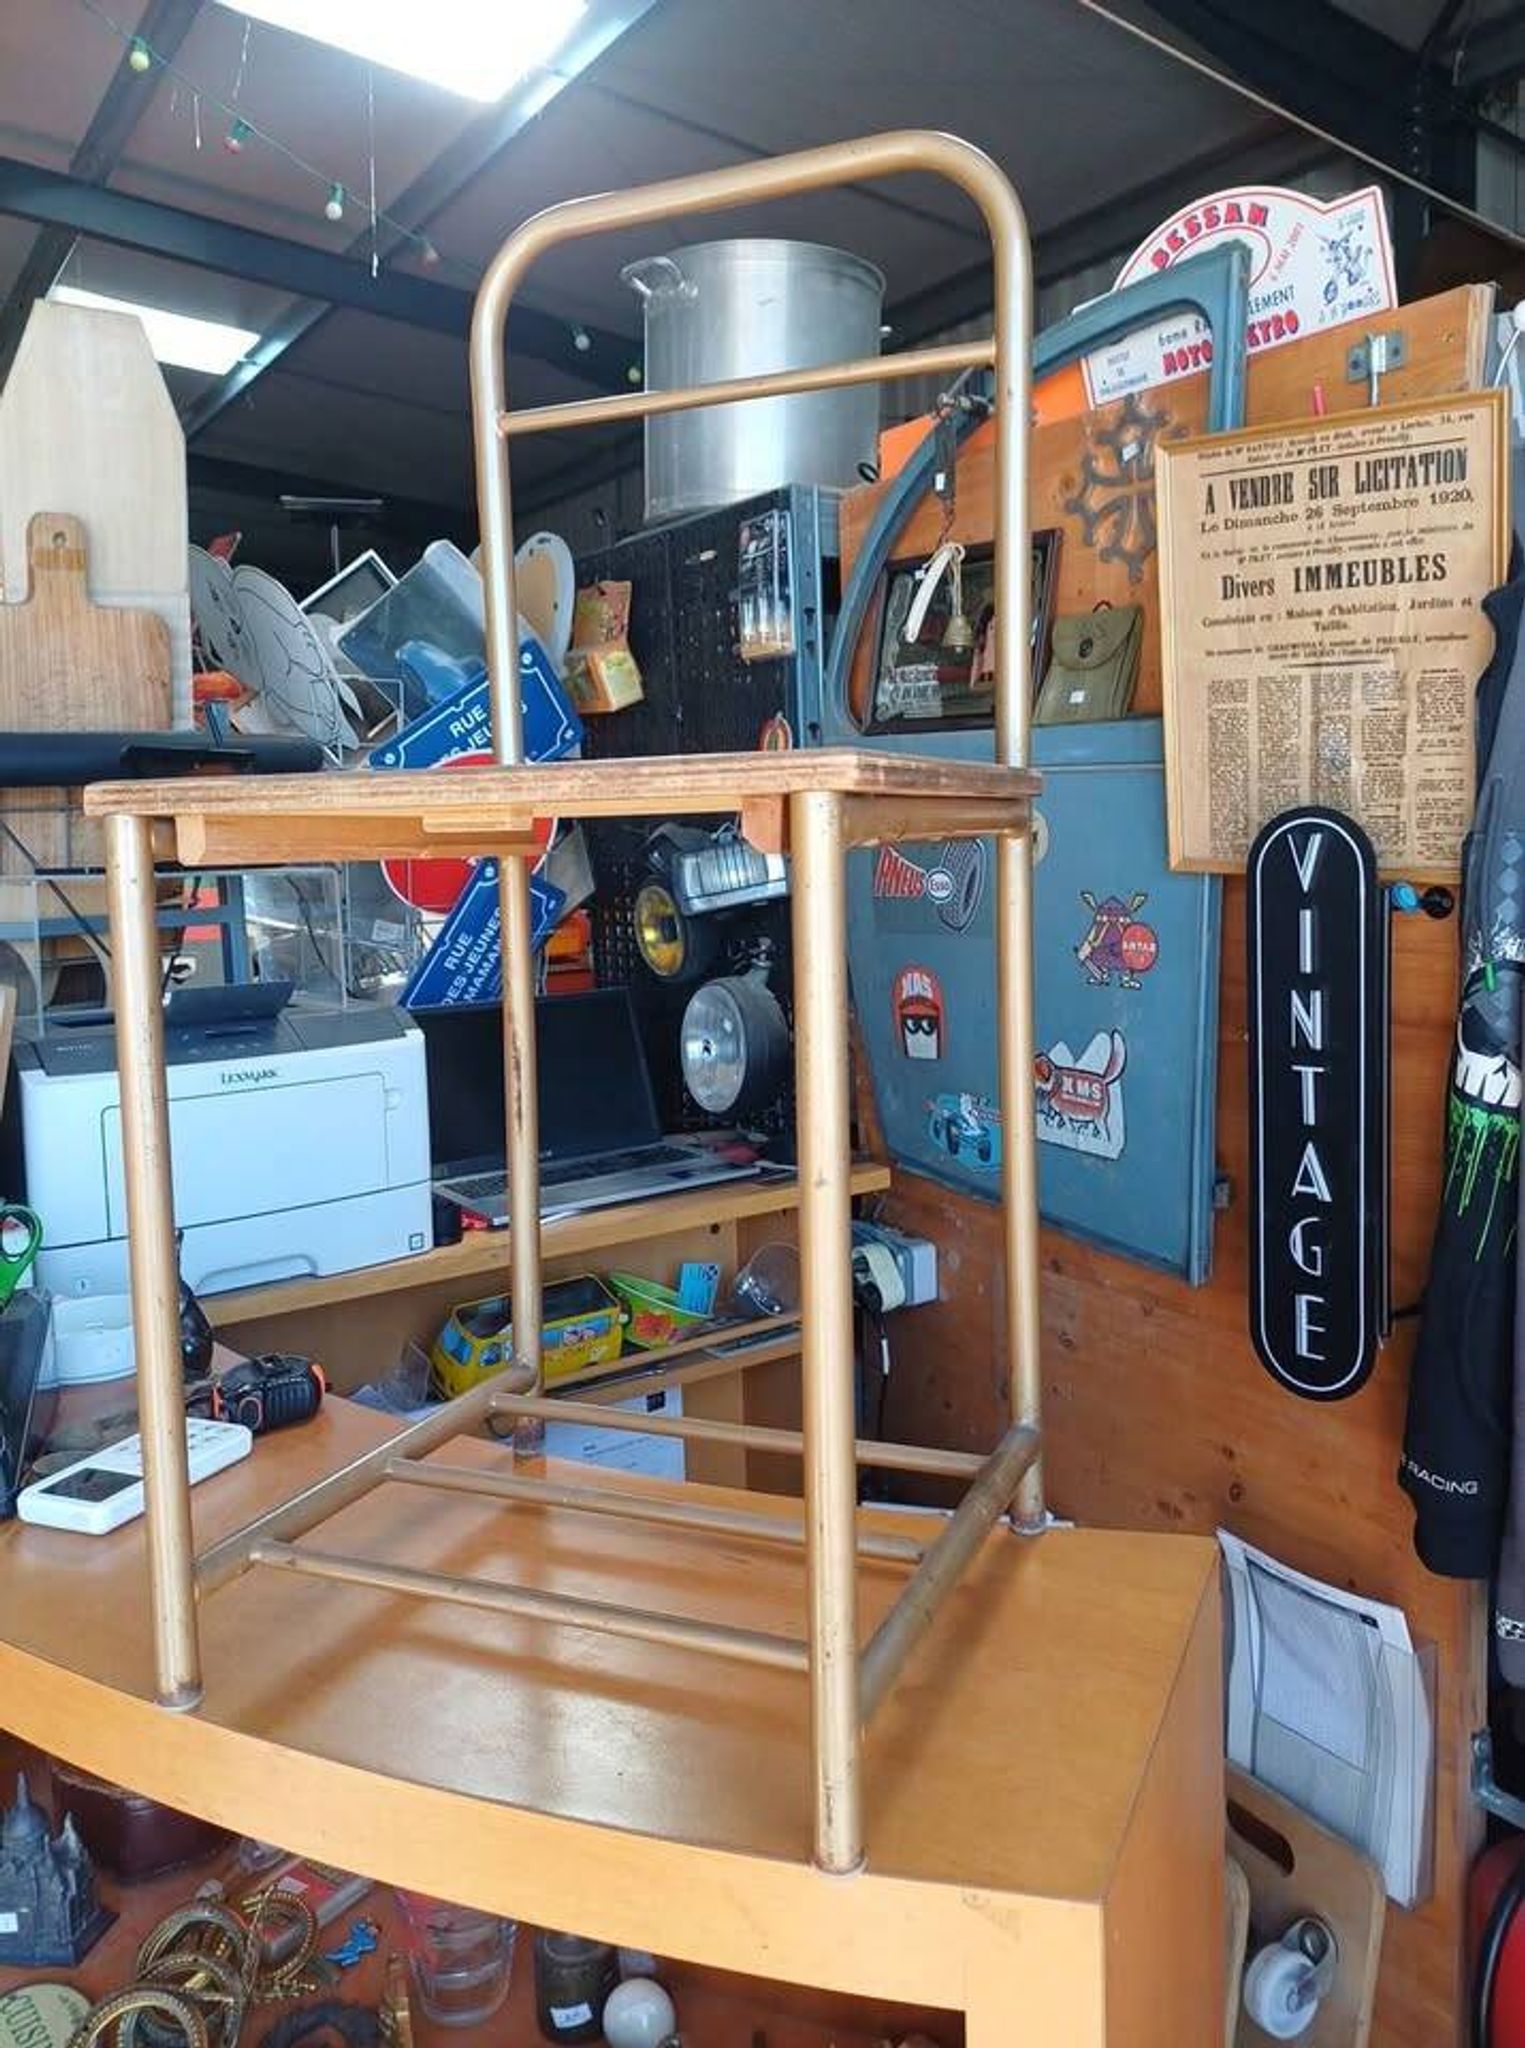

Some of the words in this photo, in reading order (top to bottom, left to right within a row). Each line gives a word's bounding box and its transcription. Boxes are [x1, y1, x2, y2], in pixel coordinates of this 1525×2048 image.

[1205, 483, 1216, 515] A
[1229, 472, 1294, 510] VENDRE
[1309, 465, 1339, 500] SUR
[1355, 448, 1468, 494] LICITATION
[1201, 521, 1219, 534] Le
[1224, 511, 1299, 531] Dimanche
[1305, 506, 1324, 521] 26
[1332, 497, 1420, 518] Septembre
[1221, 573, 1276, 600] Divers
[1294, 553, 1447, 593] IMMEUBLES
[450, 705, 487, 738] RUE
[444, 932, 473, 970] RUE
[1287, 832, 1332, 1361] VINTAGE
